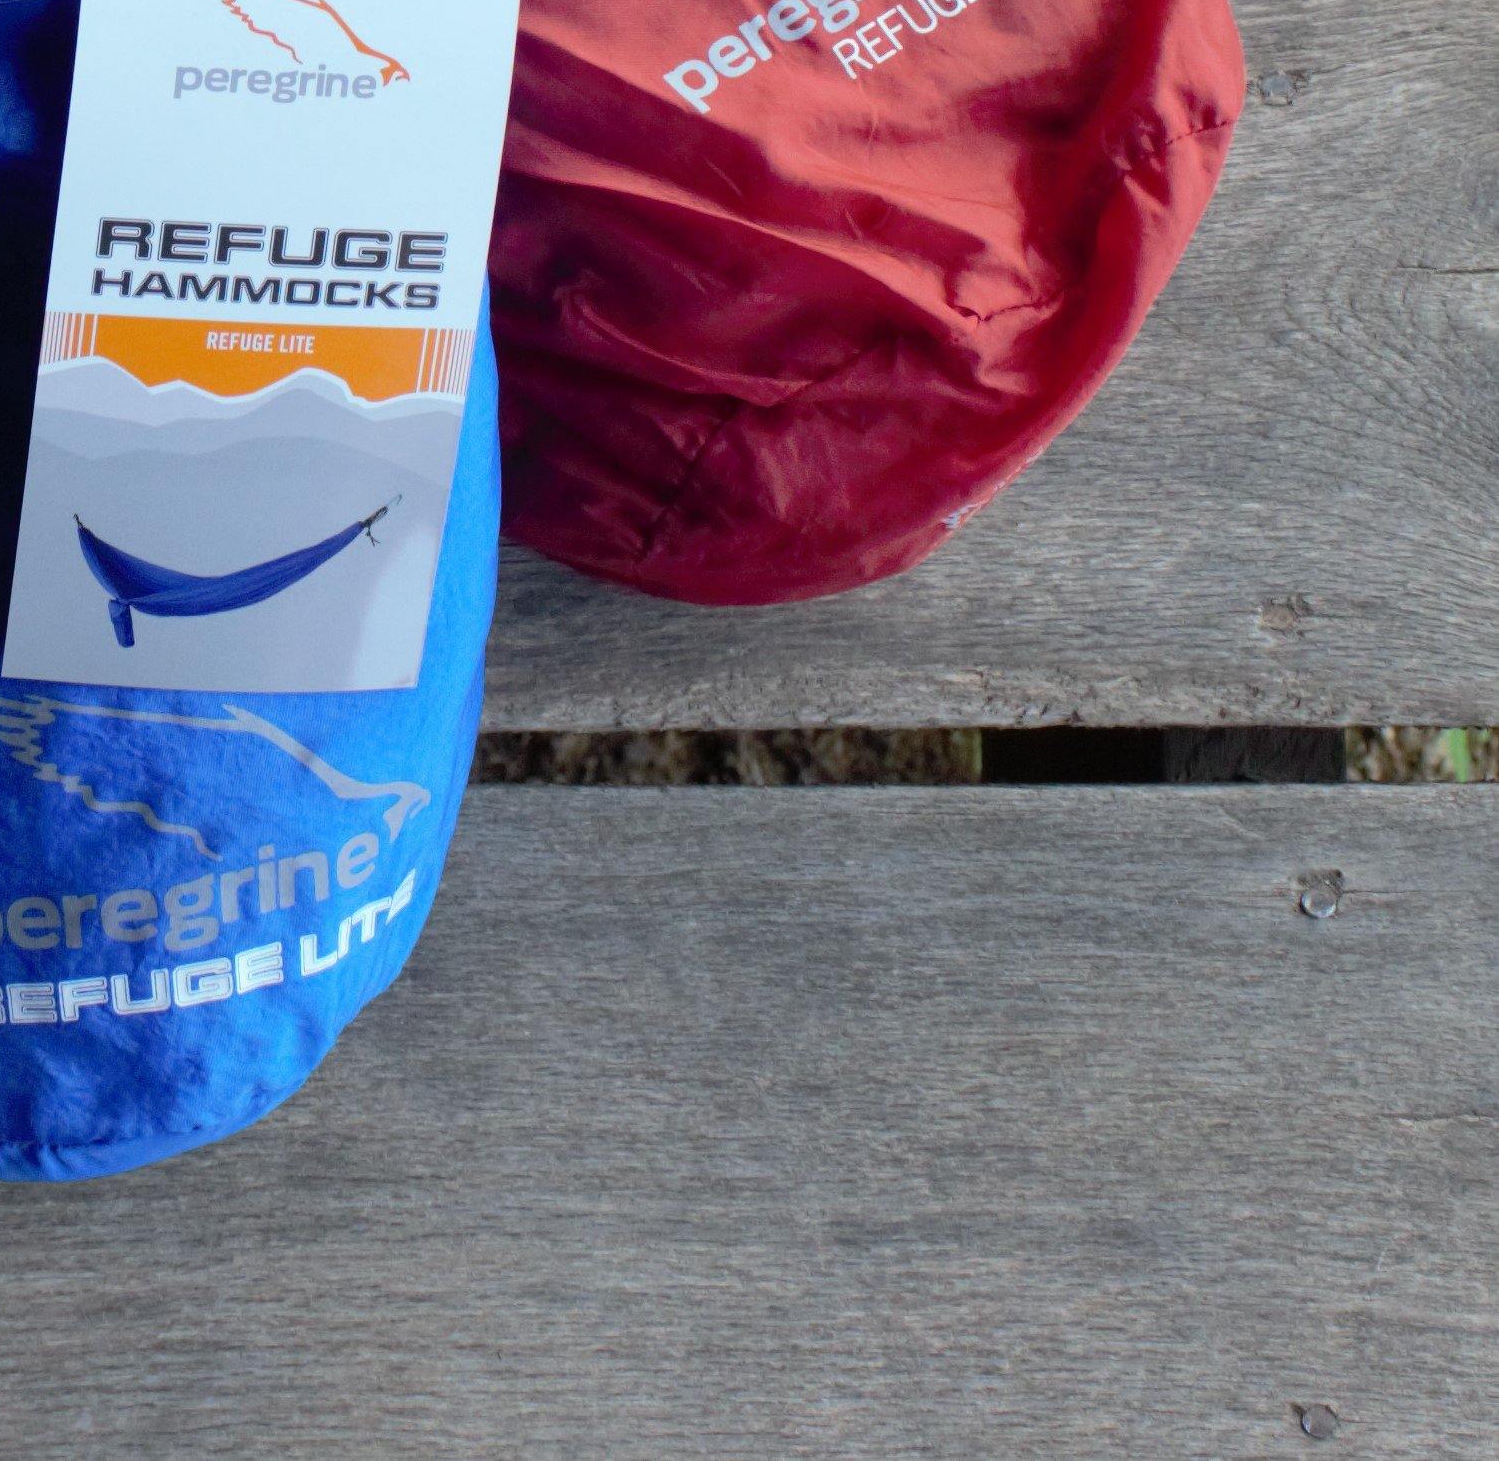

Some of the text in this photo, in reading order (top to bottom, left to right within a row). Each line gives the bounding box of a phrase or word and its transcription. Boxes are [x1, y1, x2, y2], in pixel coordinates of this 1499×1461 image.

[173, 63, 378, 104] peregrine
[95, 216, 449, 274] REFUGE
[91, 268, 441, 311] HAMMOCKS
[206, 330, 315, 355] REFUGE LITE
